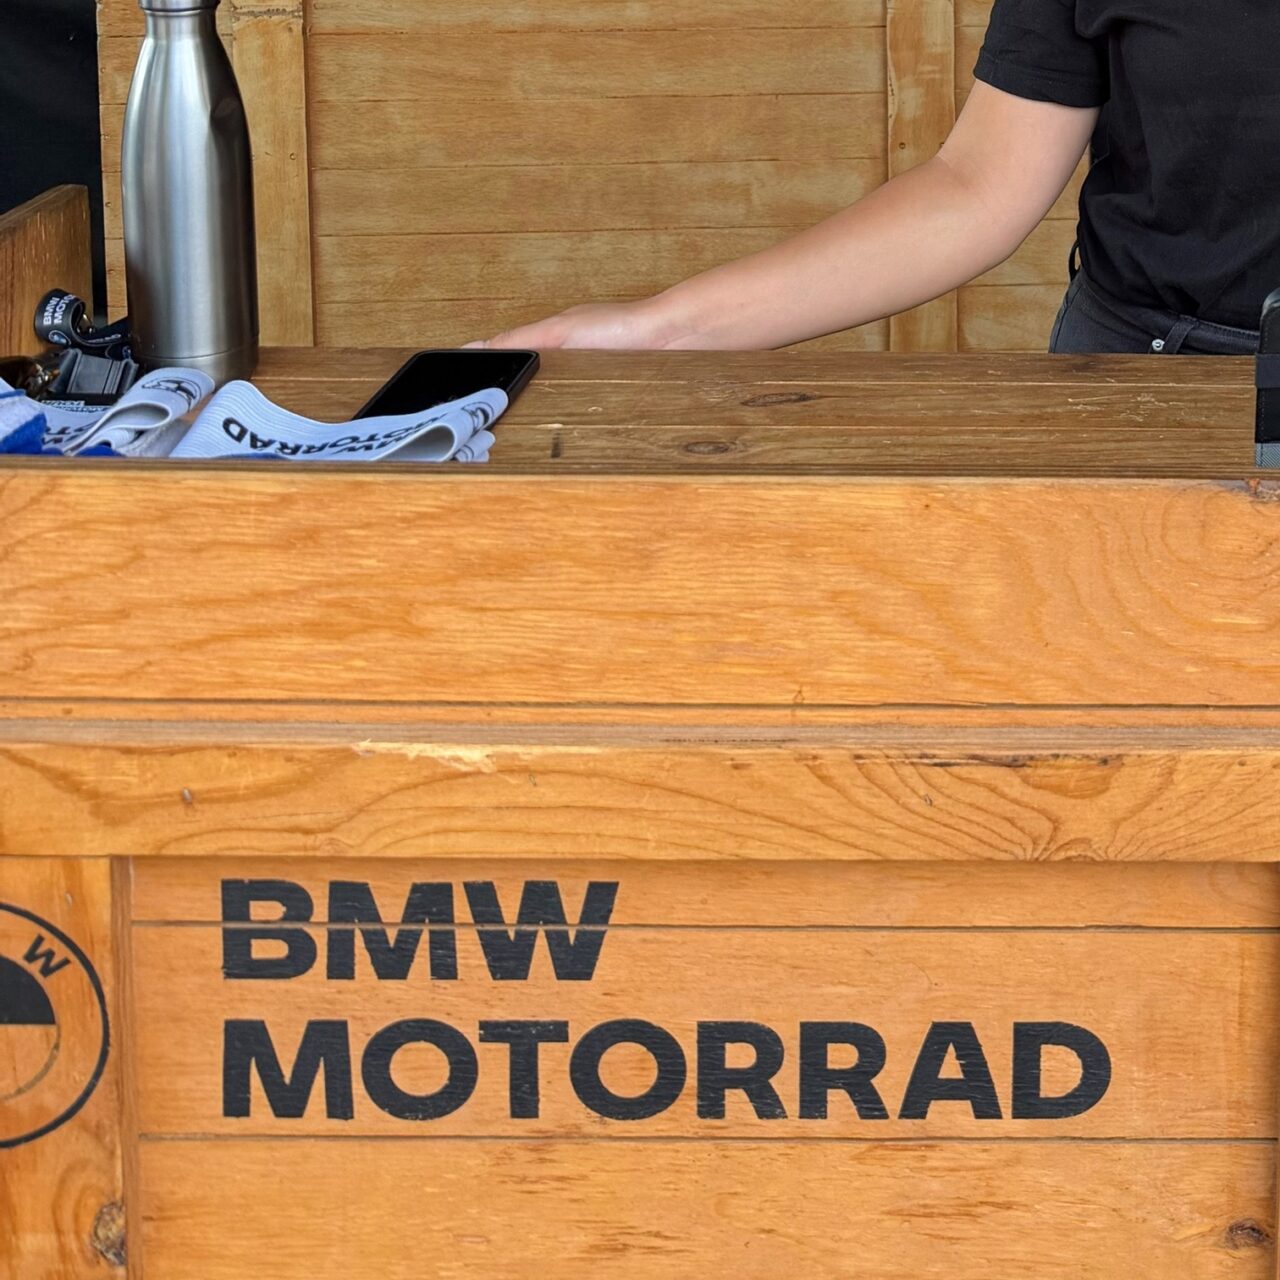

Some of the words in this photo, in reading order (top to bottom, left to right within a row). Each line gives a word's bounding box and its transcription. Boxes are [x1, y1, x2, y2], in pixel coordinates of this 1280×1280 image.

[42, 296, 61, 326] BMW
[221, 877, 621, 982] BMW
[222, 1017, 1113, 1122] MOTORRAD
